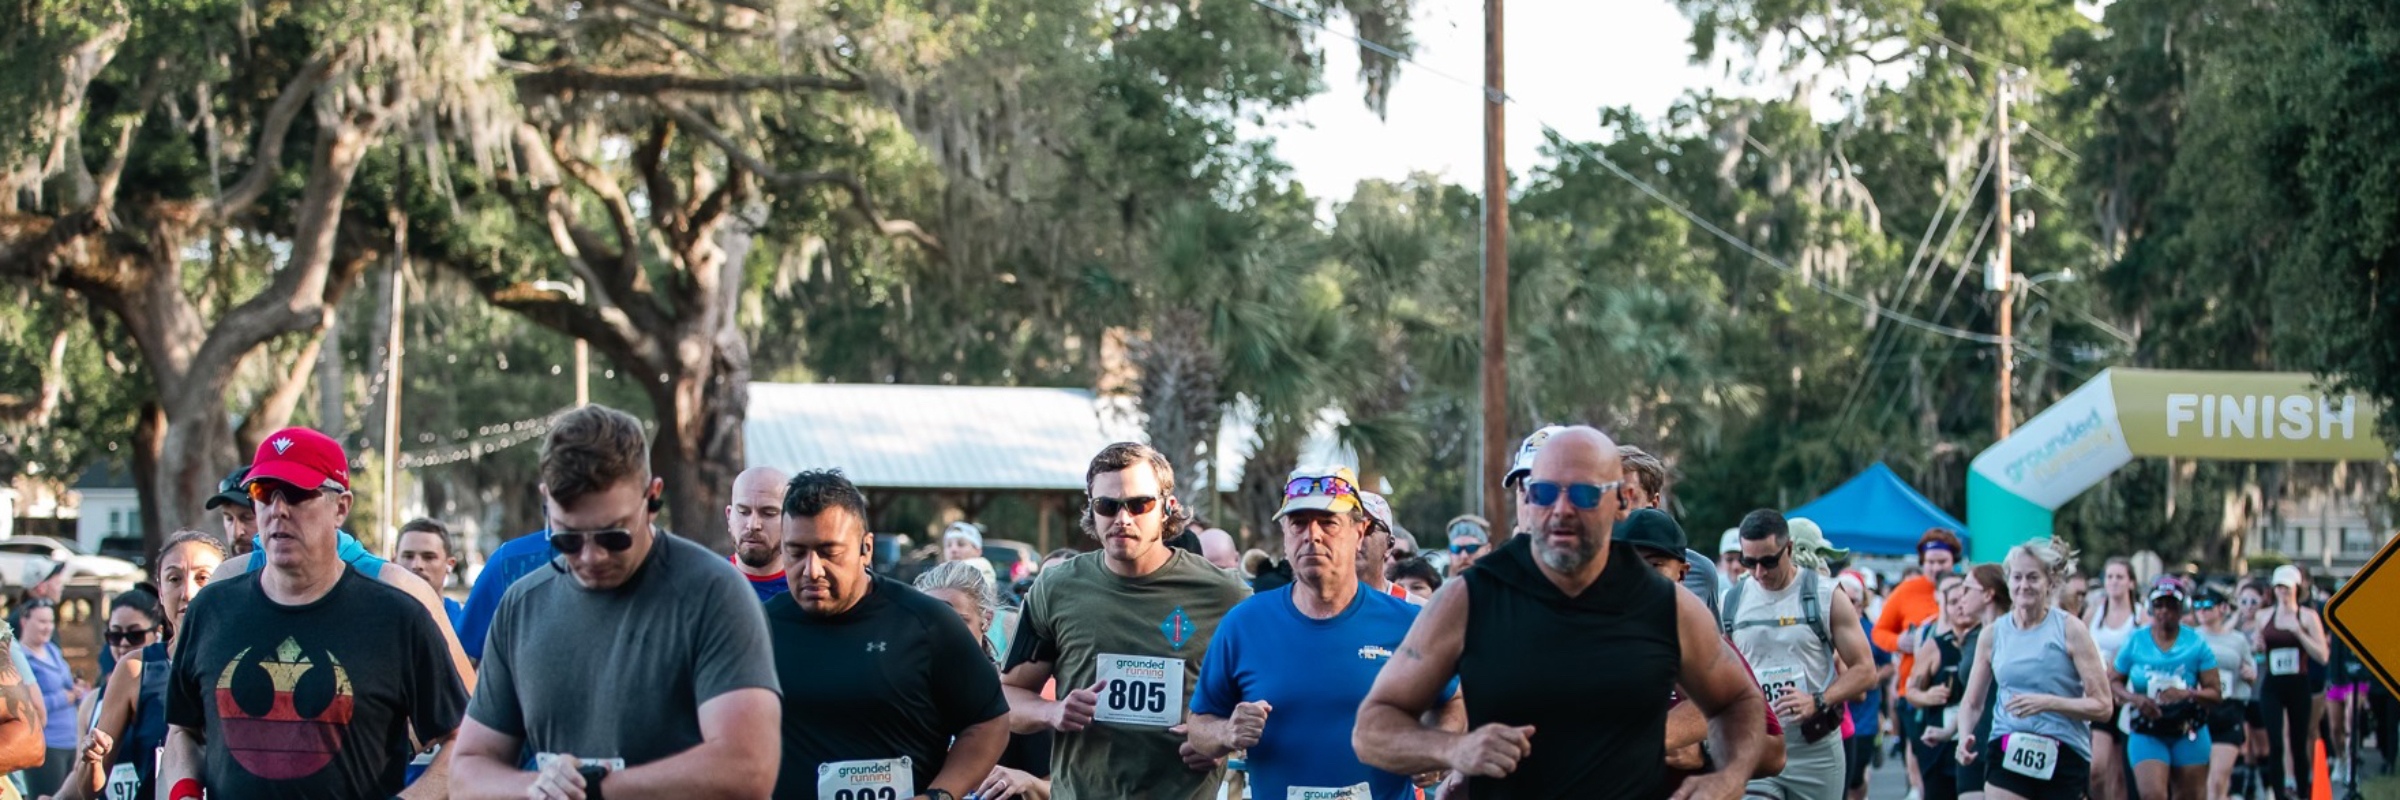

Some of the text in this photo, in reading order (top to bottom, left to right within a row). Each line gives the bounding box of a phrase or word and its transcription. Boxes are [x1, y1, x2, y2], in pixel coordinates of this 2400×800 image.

[2167, 393, 2356, 440] FINISH
[2004, 407, 2103, 484] grounded
[1116, 659, 1165, 670] grounded
[1126, 668, 1164, 679] running
[1108, 679, 1166, 713] 805
[2012, 747, 2046, 771] 463
[838, 763, 892, 779] grounded
[850, 773, 892, 783] running
[114, 781, 140, 800] 97
